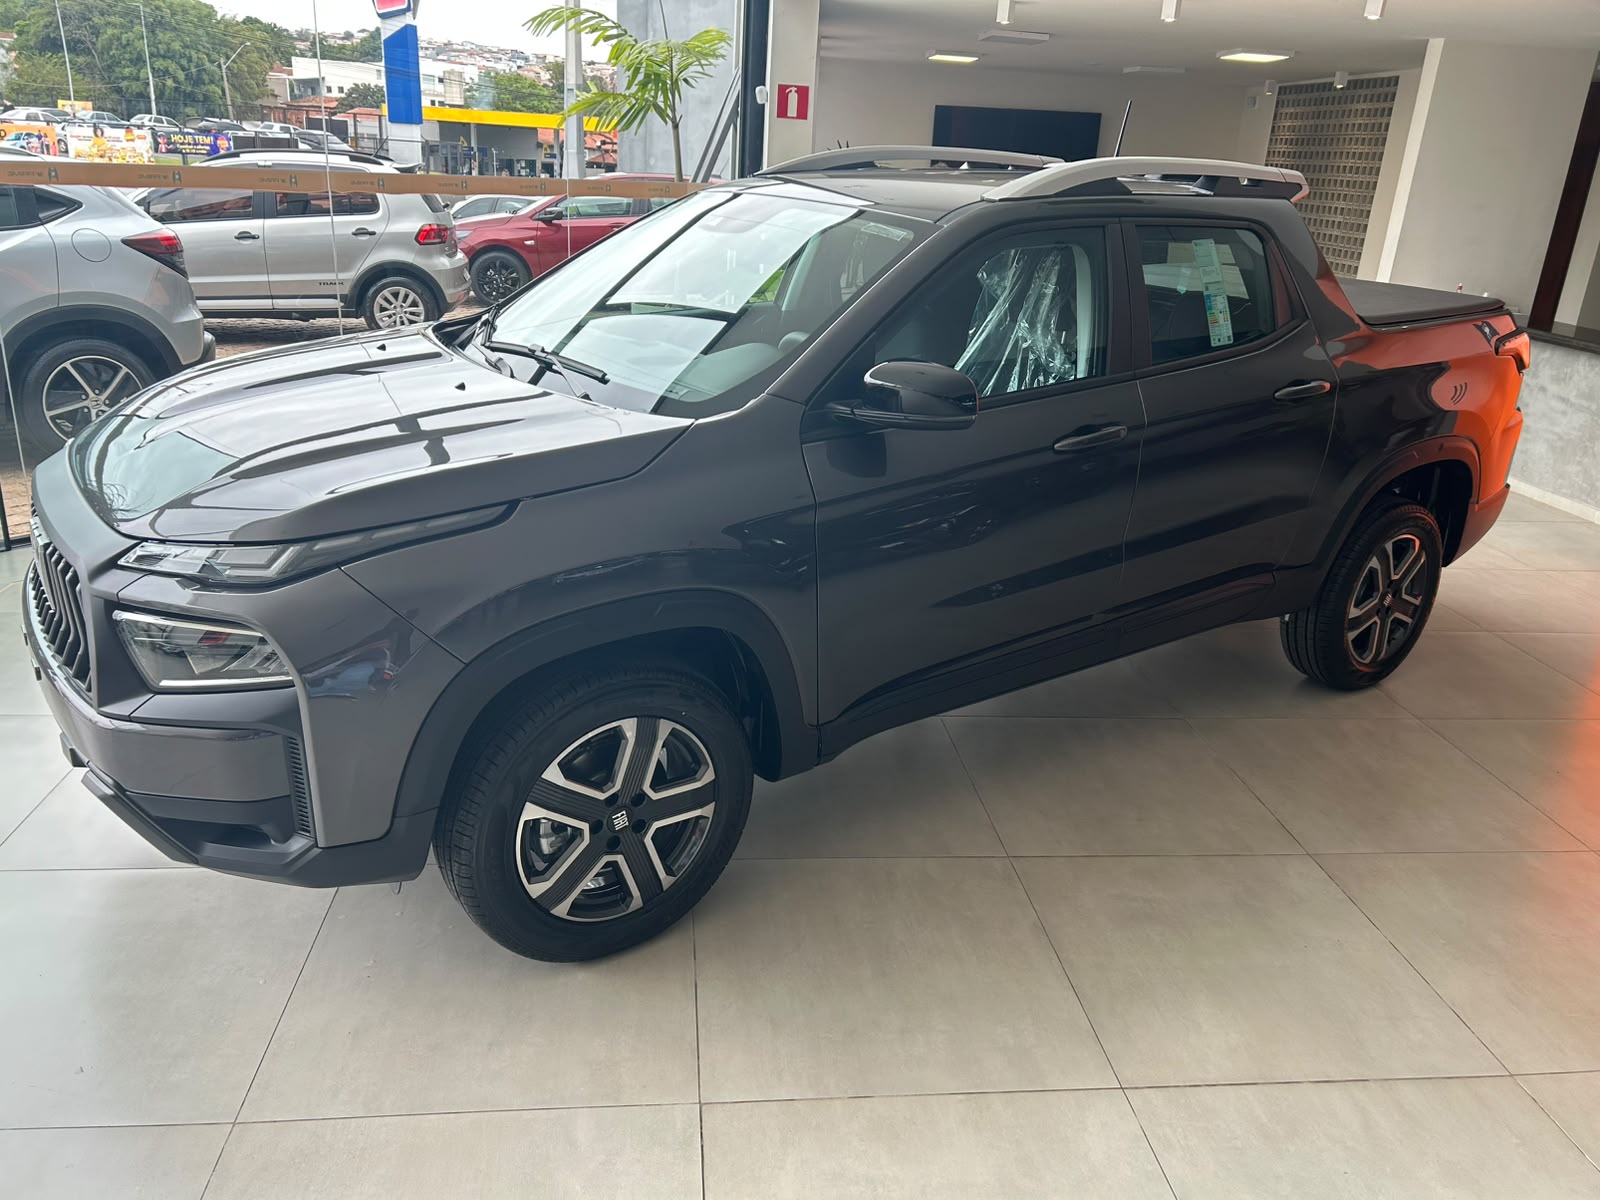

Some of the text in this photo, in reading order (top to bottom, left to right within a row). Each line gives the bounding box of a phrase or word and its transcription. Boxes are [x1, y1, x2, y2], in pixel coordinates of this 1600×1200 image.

[170, 134, 193, 144] HOJE
[194, 135, 214, 145] TEM!
[612, 810, 629, 831] FIAT
